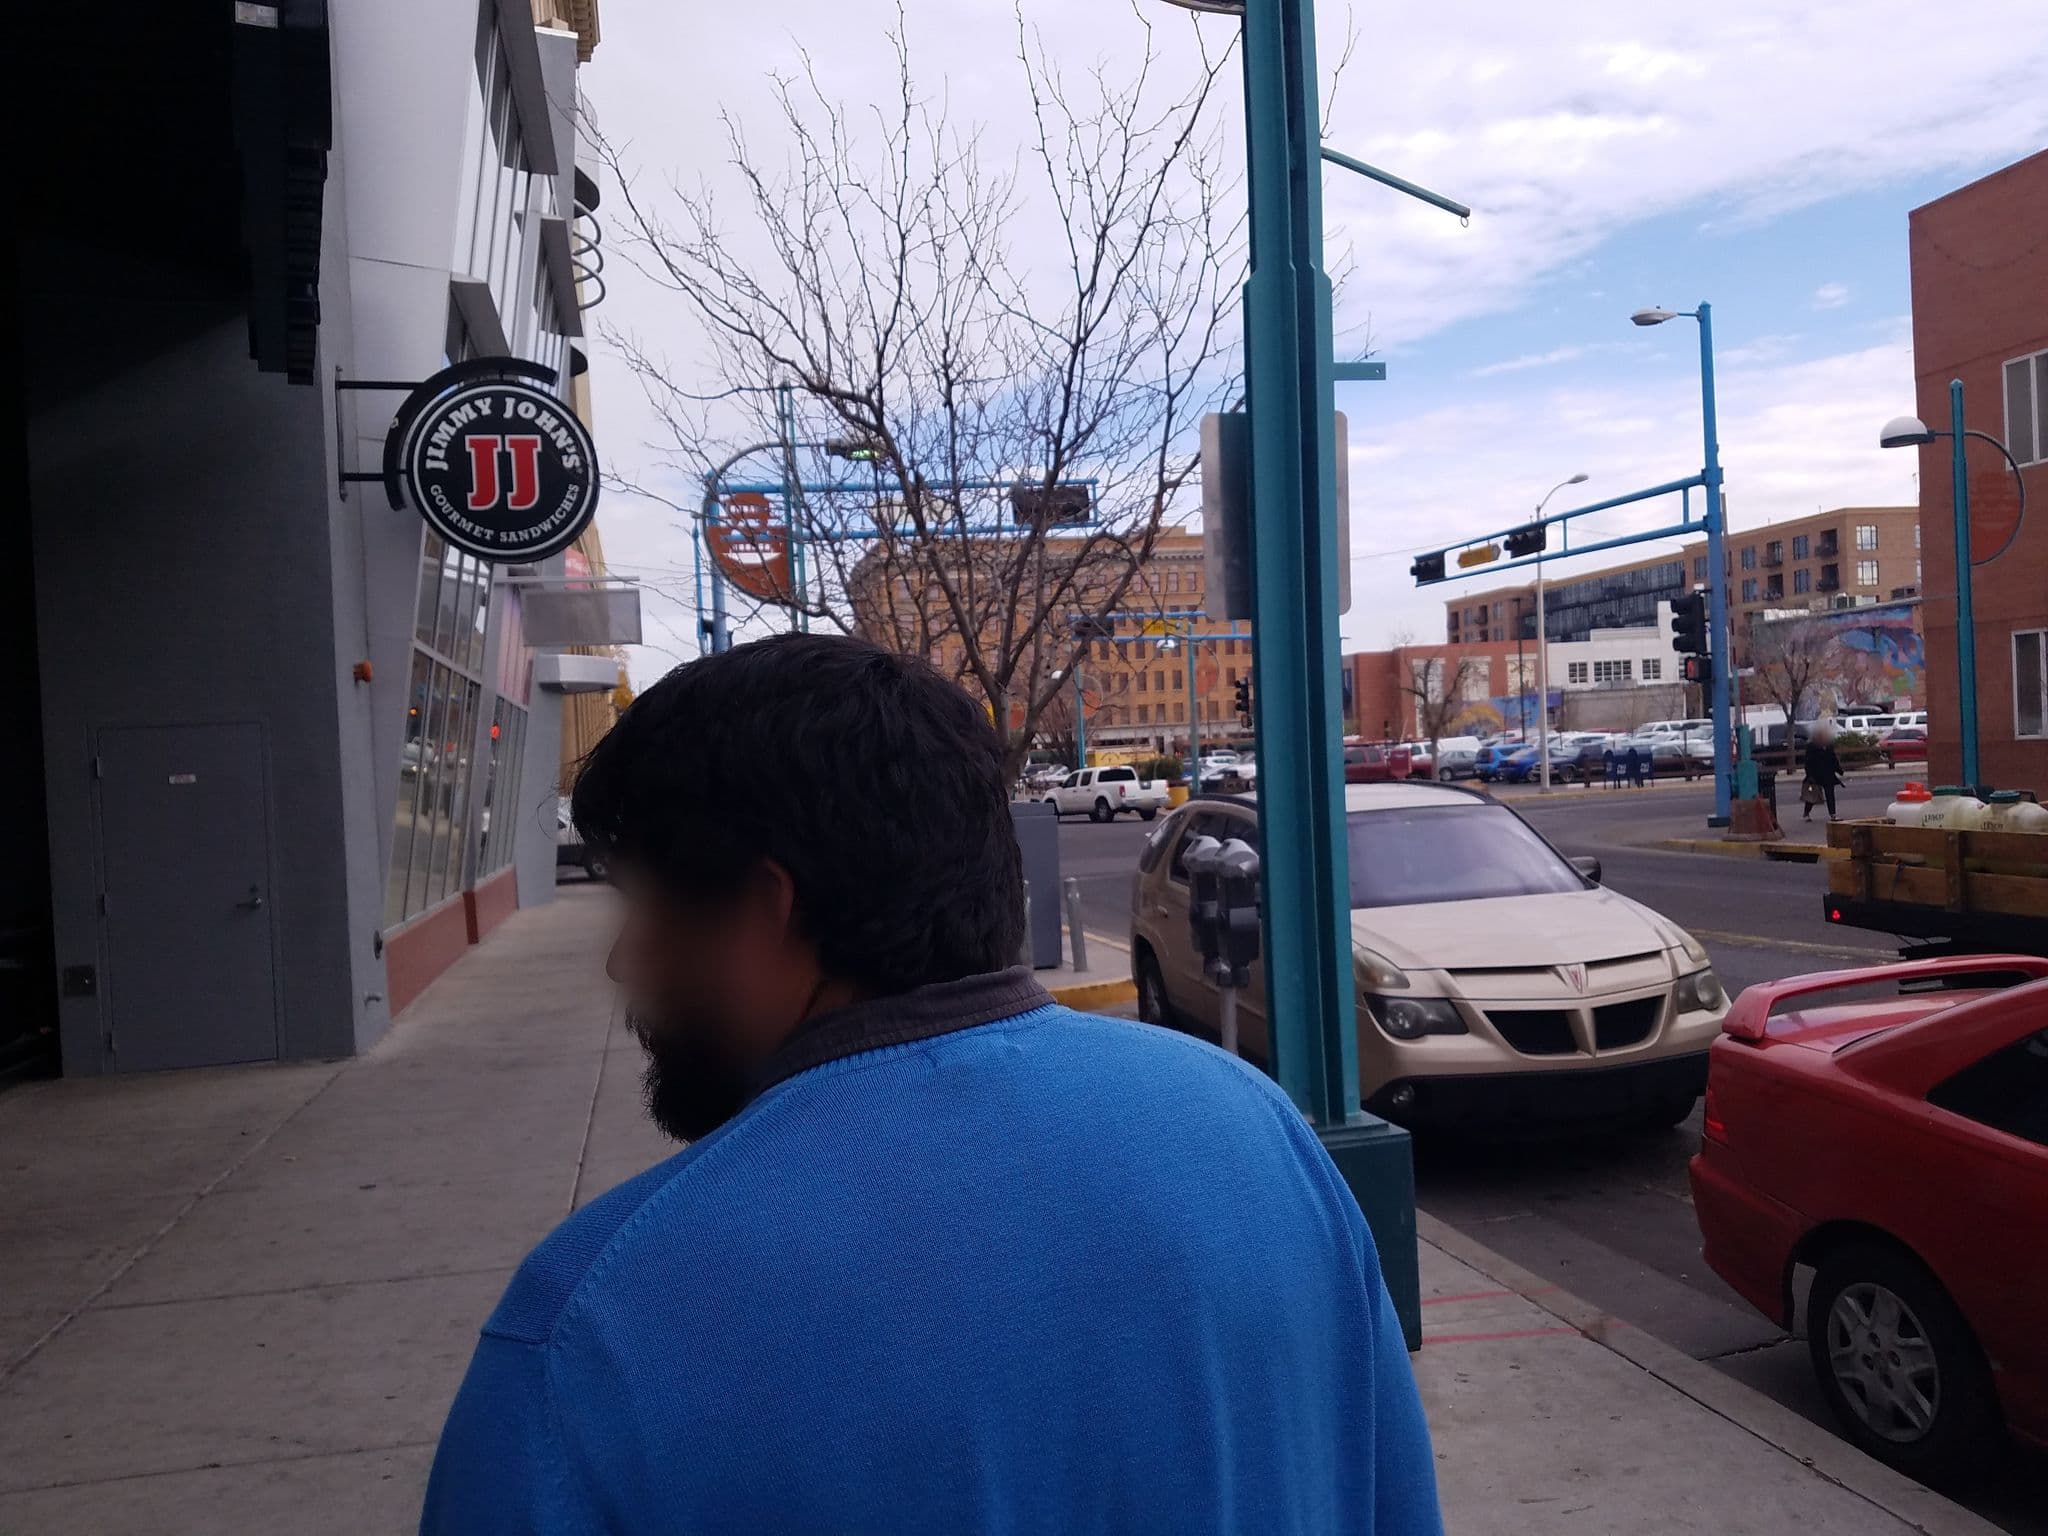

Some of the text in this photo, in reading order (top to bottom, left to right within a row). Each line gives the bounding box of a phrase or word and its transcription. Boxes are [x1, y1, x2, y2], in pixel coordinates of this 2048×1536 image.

[425, 397, 581, 471] JIMMY JOHN'S
[465, 434, 542, 511] JJ
[430, 483, 580, 543] GOURMET SANDWICHES
